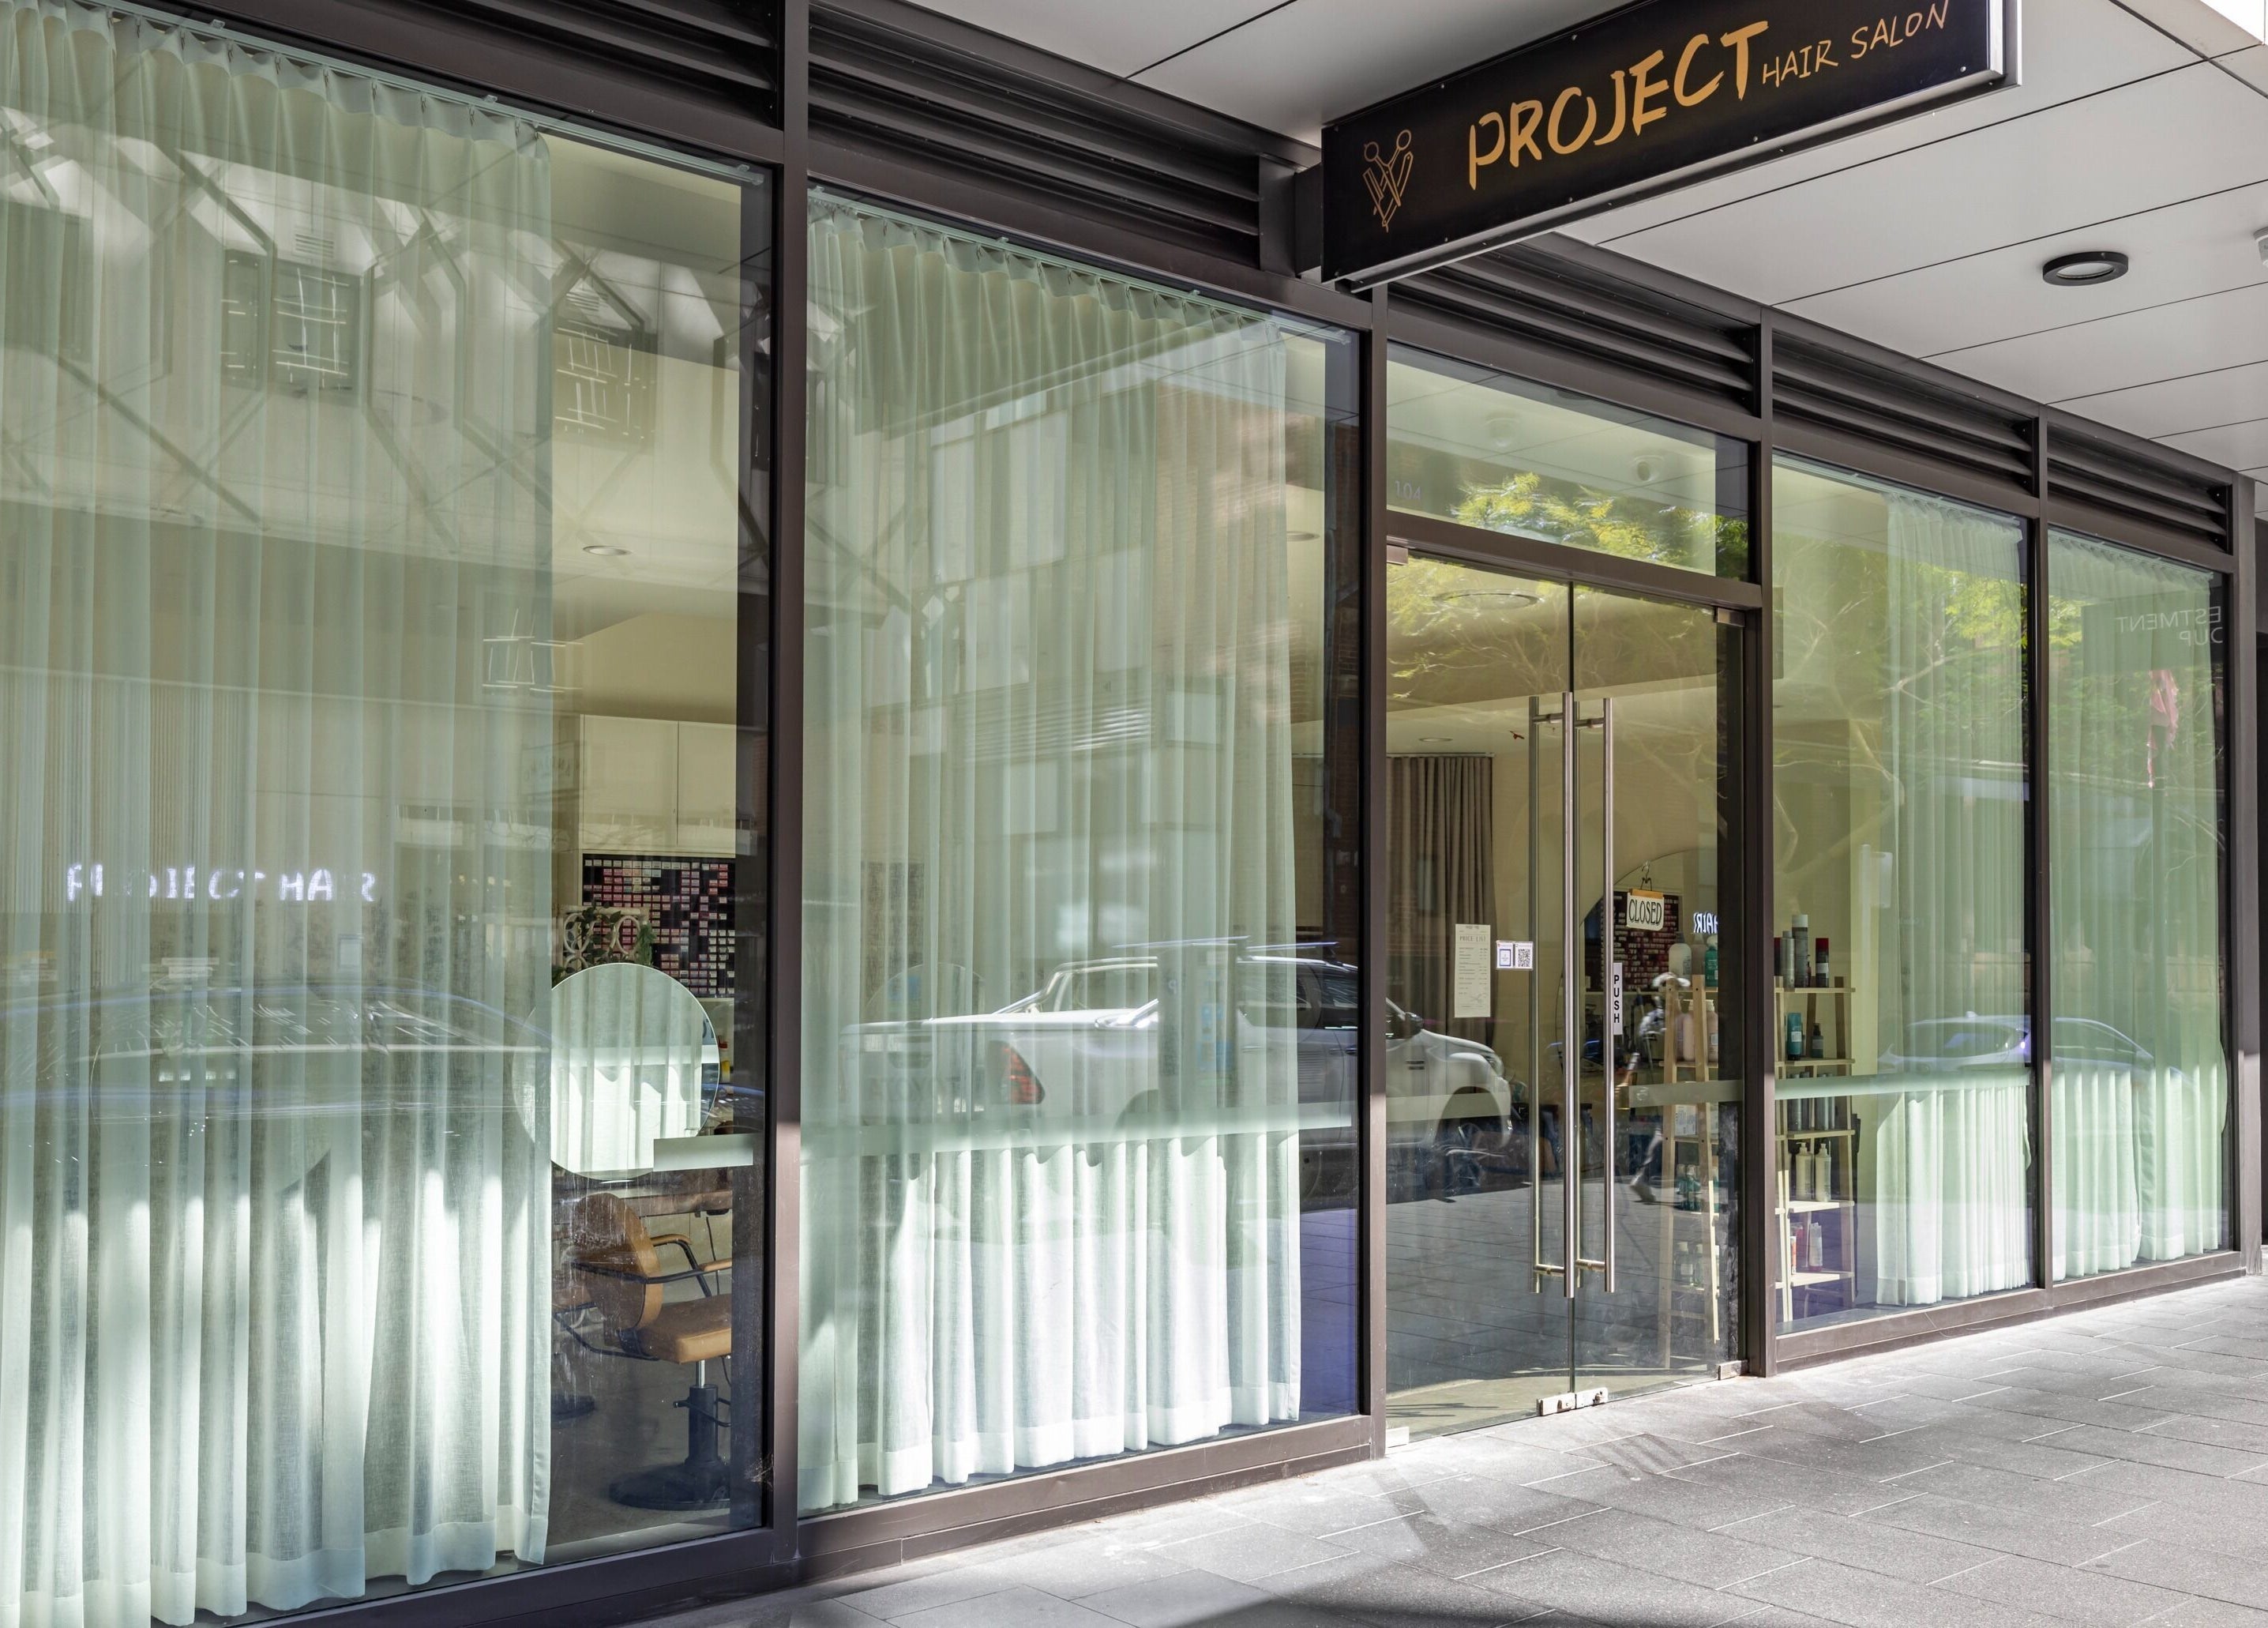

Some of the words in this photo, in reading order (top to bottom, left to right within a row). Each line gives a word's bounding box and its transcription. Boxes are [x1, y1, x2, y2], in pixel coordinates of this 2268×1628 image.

[1469, 21, 1769, 190] PROJECT
[1762, 39, 1838, 88] HAIR
[1850, 0, 1948, 58] SALON
[279, 869, 376, 902] HAR
[1628, 899, 1662, 927] CLOSED
